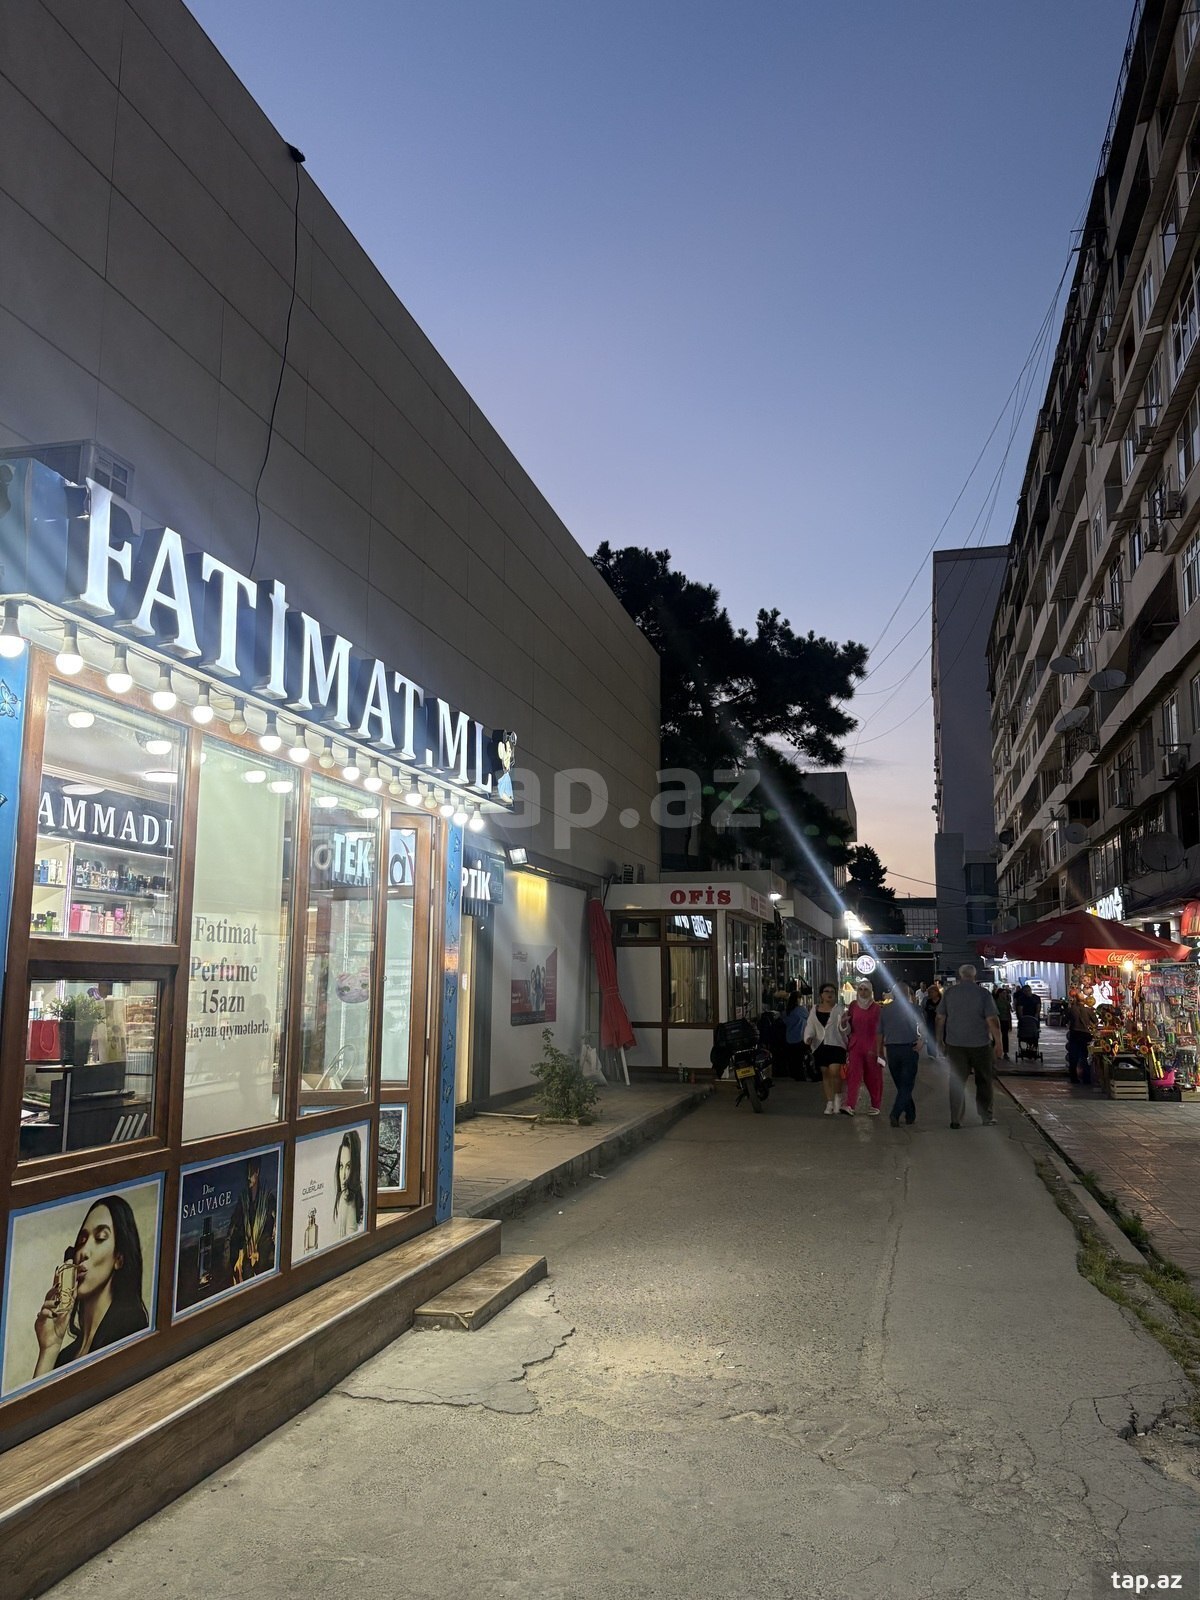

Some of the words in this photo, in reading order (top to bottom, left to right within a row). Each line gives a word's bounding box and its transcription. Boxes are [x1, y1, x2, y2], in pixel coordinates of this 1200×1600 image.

[670, 886, 731, 905] OFİS
[194, 916, 258, 945] Fatimat
[190, 956, 258, 982] Perfume
[200, 989, 245, 1014] 15azn
[183, 1191, 231, 1219] SAUVAGE
